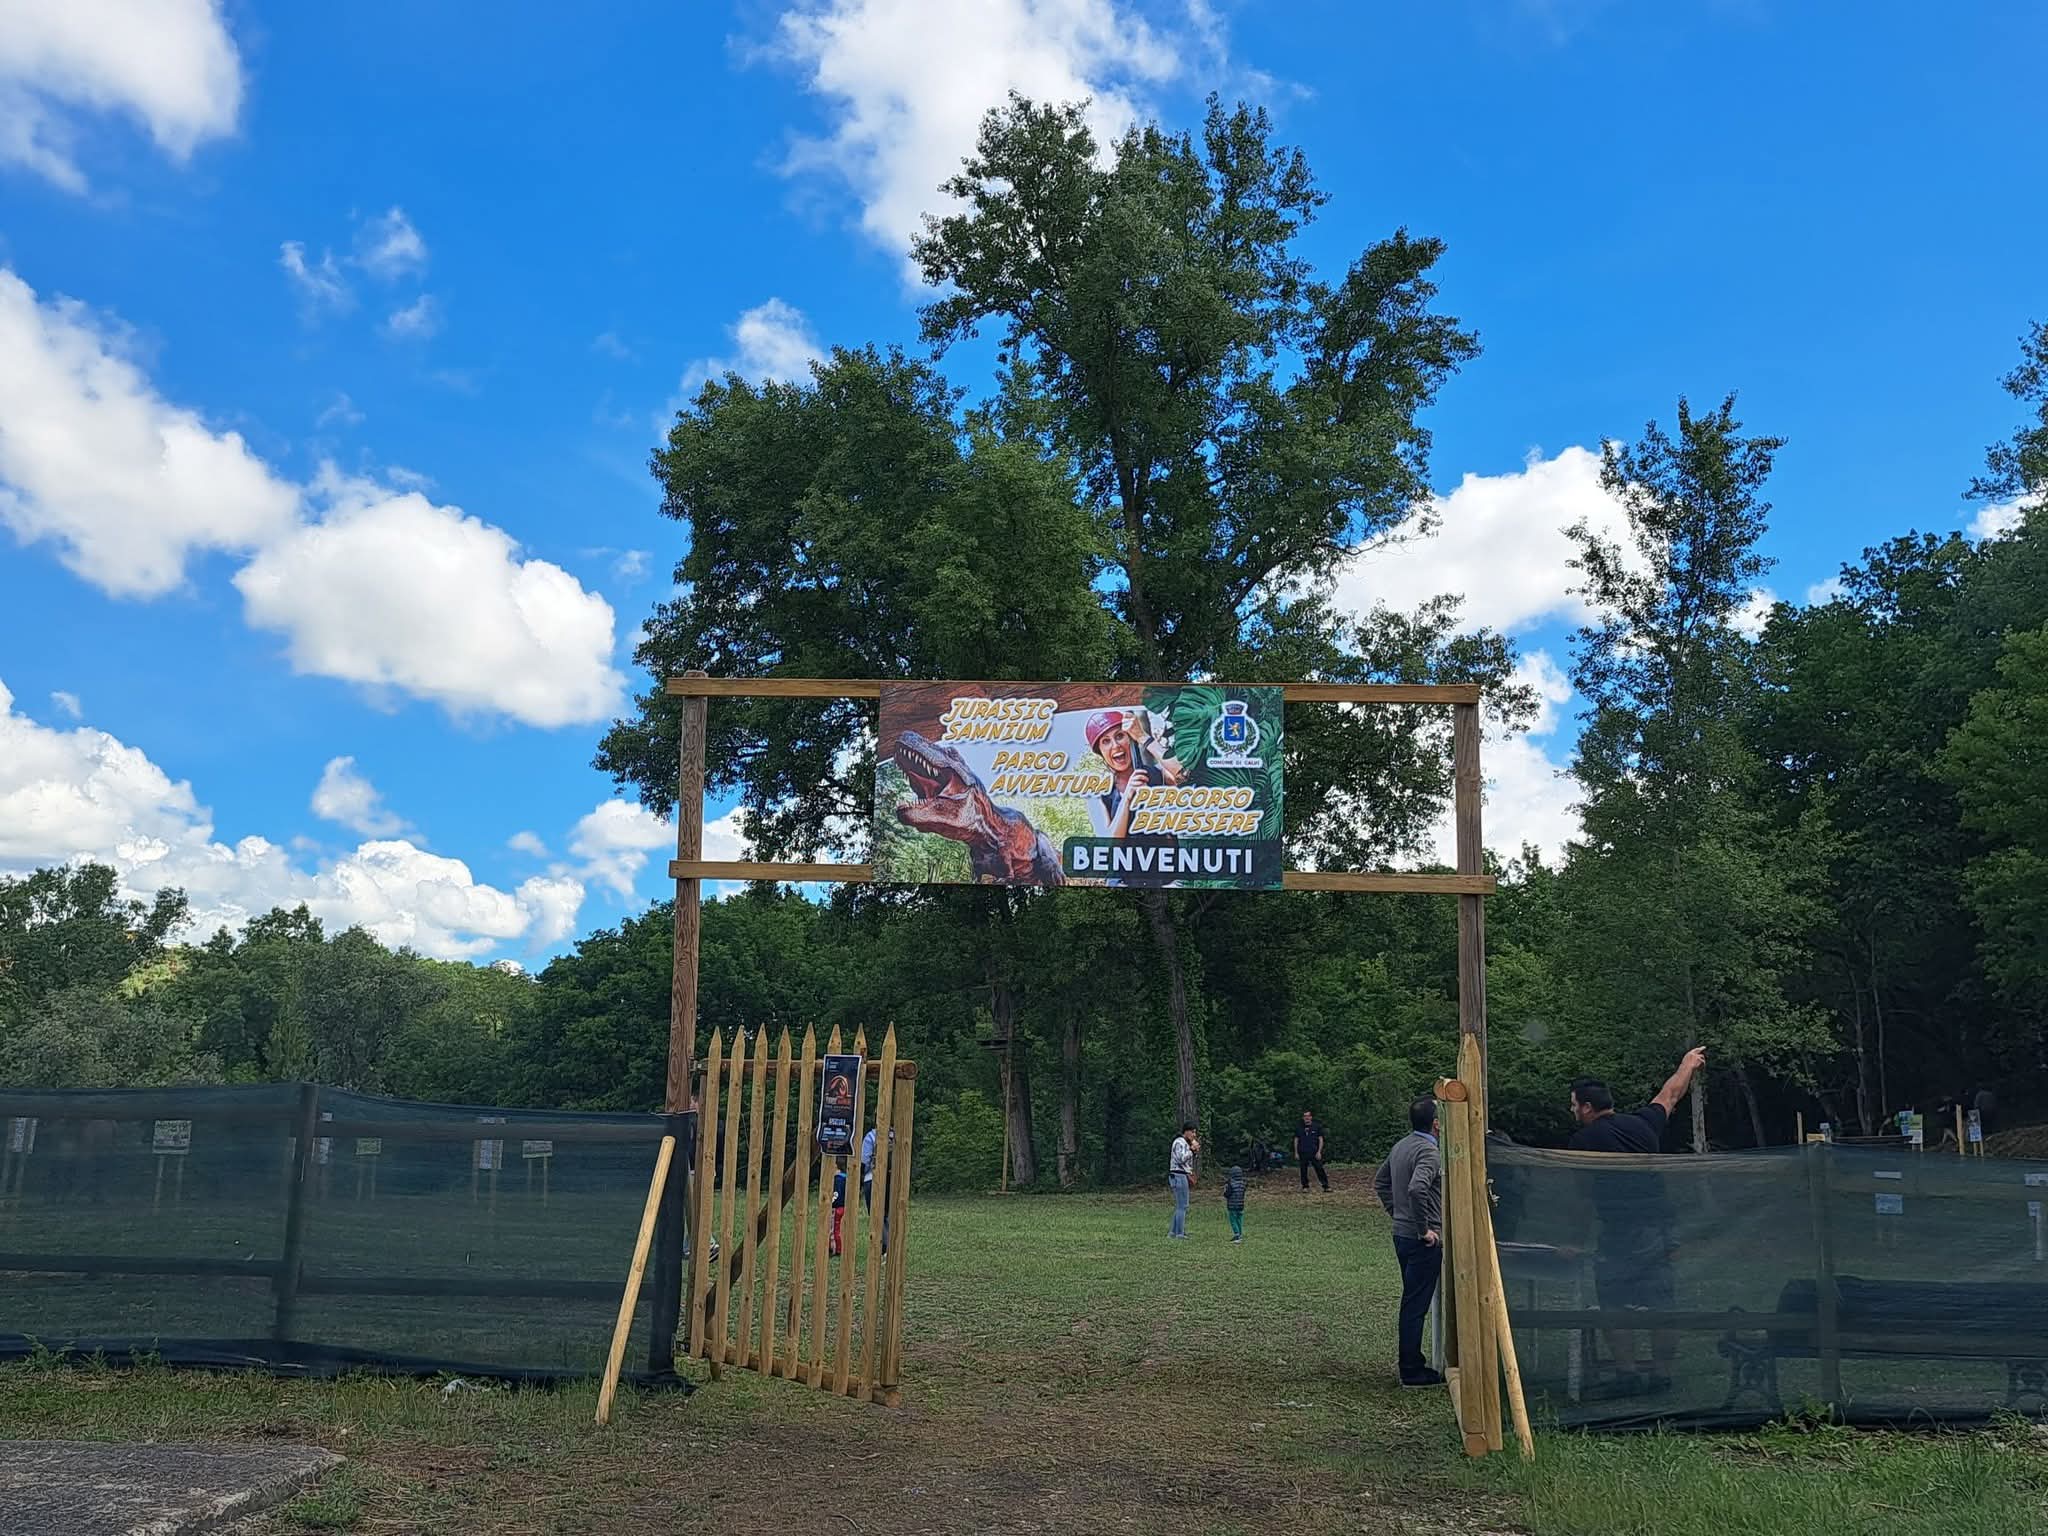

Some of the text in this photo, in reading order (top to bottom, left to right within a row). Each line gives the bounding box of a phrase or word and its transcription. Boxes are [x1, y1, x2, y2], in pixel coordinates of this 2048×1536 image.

[944, 700, 1055, 721] JURASSIC
[944, 720, 1048, 741] SAMNIUM
[992, 752, 1066, 770] PARCO
[991, 775, 1112, 794] AVVENTURA
[1133, 788, 1251, 809] PERCORSO
[1131, 811, 1259, 834] BENESSERE
[1073, 847, 1253, 873] BENVENUTI
